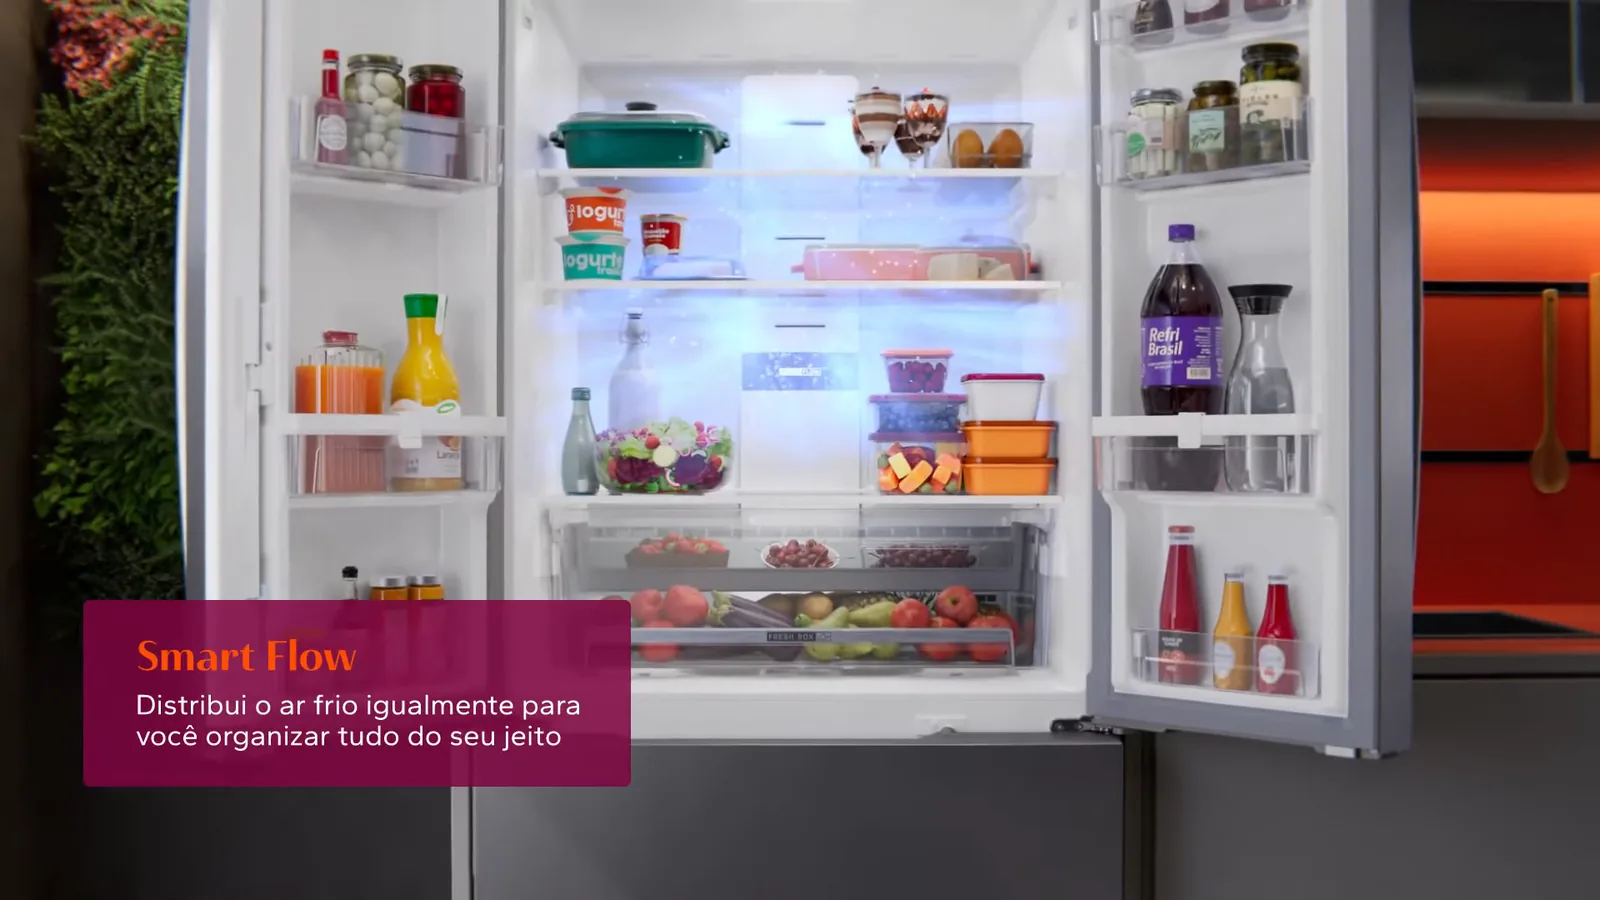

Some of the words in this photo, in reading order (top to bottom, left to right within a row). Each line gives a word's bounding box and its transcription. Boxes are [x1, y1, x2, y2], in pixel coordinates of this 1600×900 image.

[1150, 327, 1180, 341] Refri
[1148, 341, 1183, 355] Brasil
[797, 632, 815, 641] BOX
